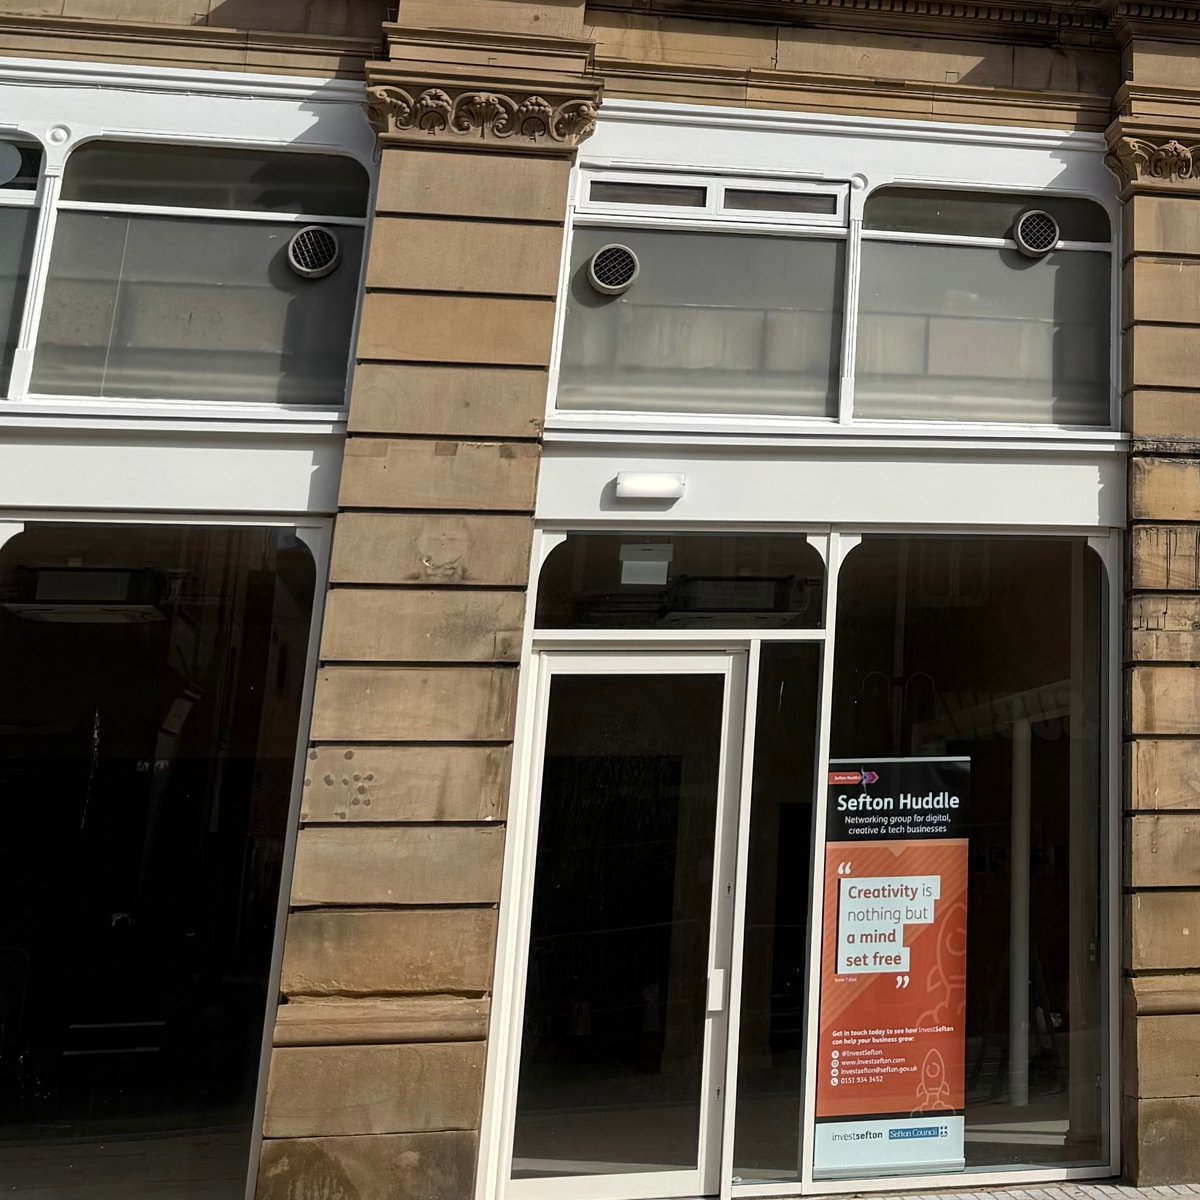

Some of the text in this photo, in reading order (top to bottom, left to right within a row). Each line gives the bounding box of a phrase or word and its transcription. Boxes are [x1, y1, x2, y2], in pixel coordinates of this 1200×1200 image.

[837, 791, 960, 811] Sefton Huddle
[845, 813, 952, 825] Networking group for digital,
[848, 824, 947, 835] creative & tech businesses
[848, 883, 933, 901] Creativity is
[847, 906, 928, 924] nothing but
[846, 928, 897, 944] a mind
[846, 951, 902, 967] set free
[868, 1028, 886, 1037] today
[843, 1038, 857, 1046] help
[857, 1038, 871, 1046] your
[898, 1035, 915, 1044] grow:
[841, 1058, 905, 1066] www.investsefton.com
[841, 1066, 917, 1074] investsefton@sefton.gov.uk
[869, 1075, 884, 1083] 3452
[832, 1127, 938, 1141] investsefton Sefton Council
